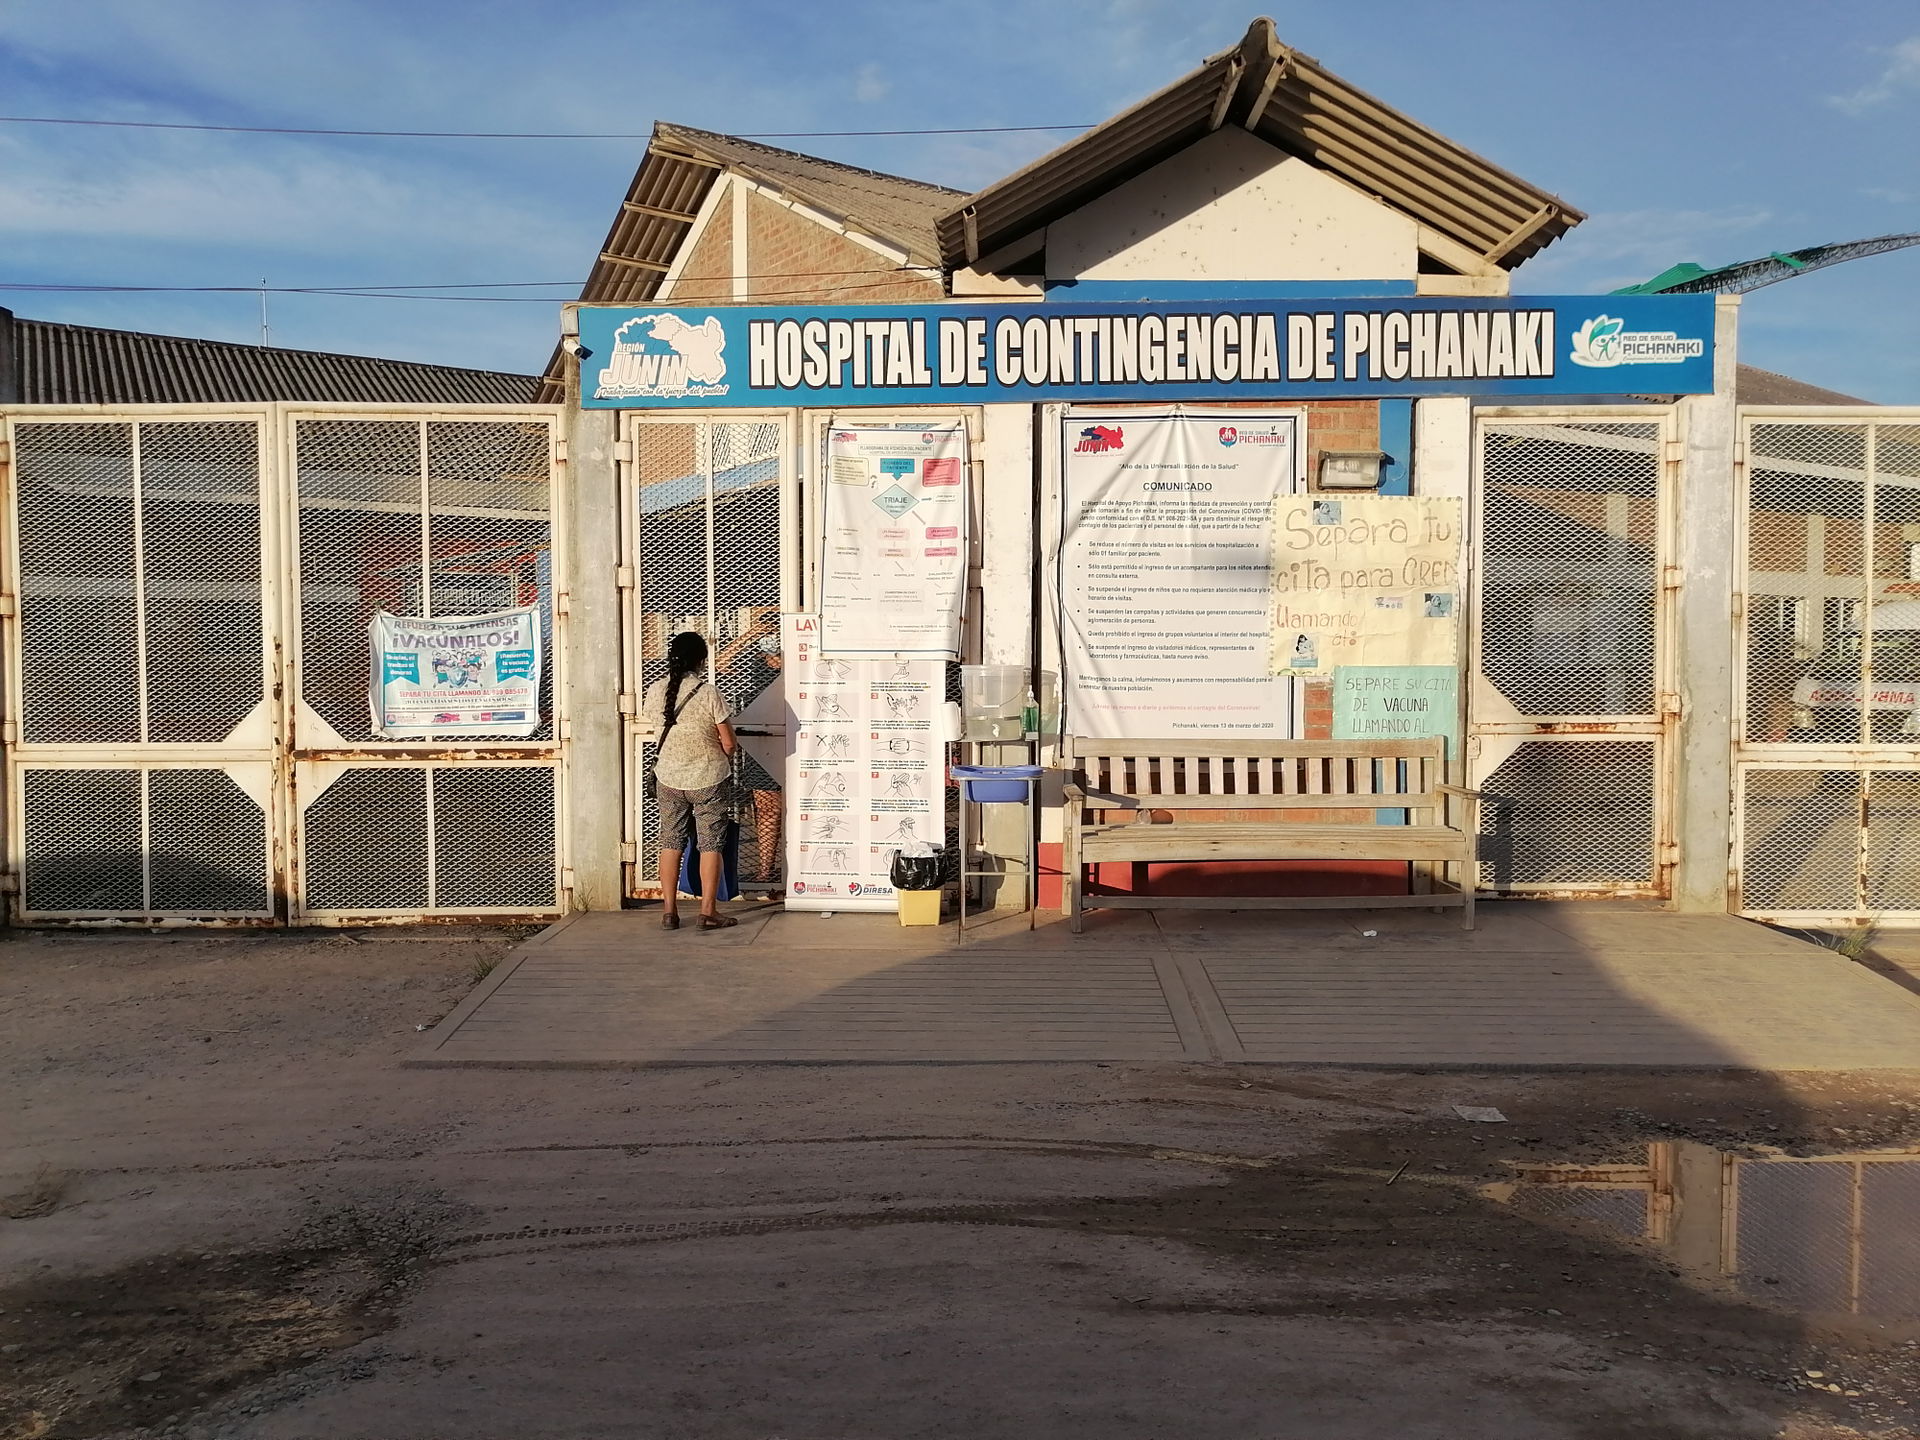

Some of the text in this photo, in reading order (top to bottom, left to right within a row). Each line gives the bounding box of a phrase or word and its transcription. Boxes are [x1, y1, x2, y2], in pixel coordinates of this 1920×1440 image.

[749, 309, 1556, 389] HOSPITAL DE CONTINGENCIA DE PICHANAKI
[1623, 342, 1700, 354] PICHANAKI
[1143, 482, 1212, 491] COMUNICADO
[1285, 508, 1409, 561] Separa
[1340, 567, 1394, 600] para
[1346, 677, 1400, 691] SEPARE
[1405, 678, 1421, 691] SU
[1354, 698, 1428, 712] DE VACUNA
[1352, 718, 1430, 733] LLAMANDO AL
